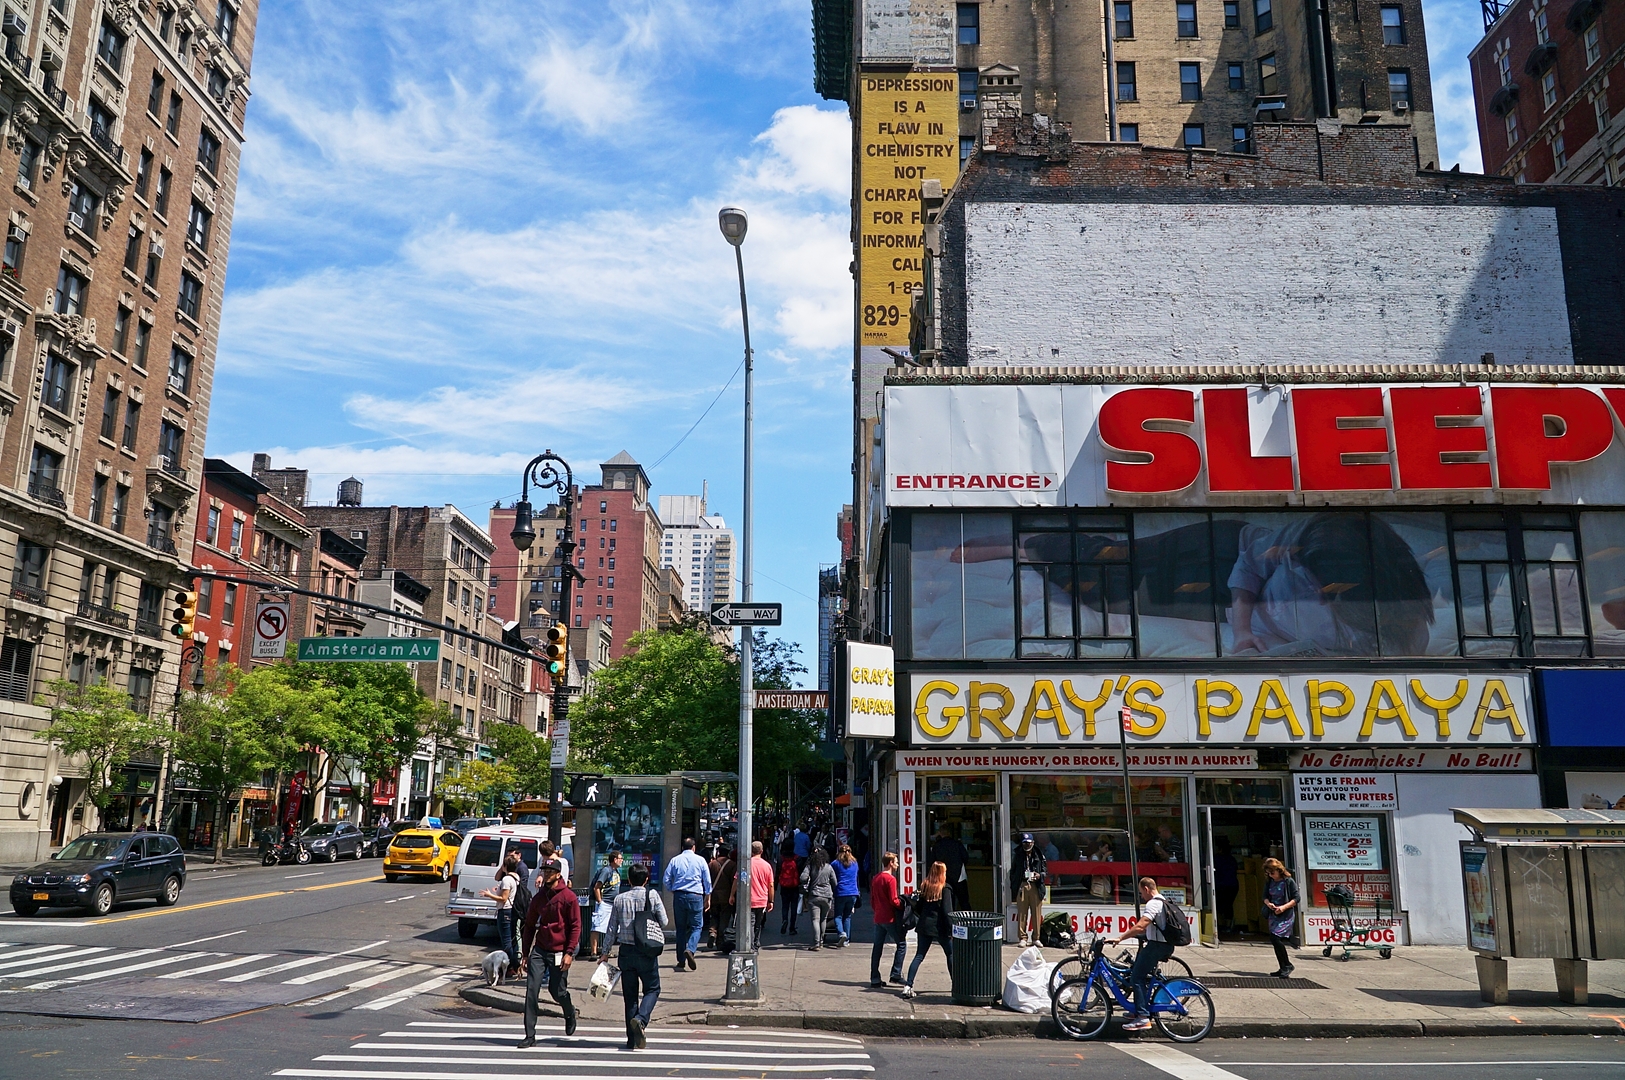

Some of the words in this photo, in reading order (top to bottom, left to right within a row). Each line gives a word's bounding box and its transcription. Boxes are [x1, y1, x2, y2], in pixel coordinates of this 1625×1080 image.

[866, 79, 954, 92] DEPRESSION
[894, 101, 908, 113] IS
[915, 102, 926, 114] A
[878, 122, 920, 135] FLAW
[928, 122, 944, 135] IN
[866, 144, 954, 157] CHEMISTRY
[894, 166, 926, 179] NOT
[873, 212, 904, 224] FOR
[862, 234, 924, 248] INFORMA
[1098, 386, 1625, 494] SLEEP
[896, 476, 1042, 490] ENTRANCE
[718, 610, 741, 619] ONE
[754, 610, 776, 619] WAY
[304, 643, 404, 656] Amsterdam
[408, 643, 432, 656] Av
[852, 666, 895, 687] GRAY'S
[758, 694, 811, 708] AMSTERDAM
[814, 694, 826, 708] AV
[851, 696, 896, 716] PAPAYA
[914, 674, 1167, 738] GRAY'S
[1194, 678, 1526, 738] PAPAYA
[904, 757, 942, 766] WHEN
[945, 756, 990, 766] YOU'RE
[992, 756, 1050, 768] HUNGRY,
[1052, 756, 1070, 766] OR
[1073, 756, 1120, 767] BROKE,
[1143, 756, 1172, 766] JUST
[1174, 756, 1188, 766] IN
[1190, 756, 1200, 766] A
[1203, 756, 1251, 766] HURRY!
[1300, 753, 1322, 768] No
[1329, 752, 1426, 768] Gimmicks!
[1446, 752, 1470, 768] No
[1475, 752, 1522, 768] Bull!
[1298, 776, 1322, 785] LET'S
[1325, 776, 1338, 785] BE
[1340, 776, 1376, 785] FRANK
[1300, 793, 1321, 801] BUY
[1324, 793, 1346, 801] OUR
[1349, 793, 1394, 801] FURTERS
[1309, 821, 1372, 829] BREAKFAST
[1348, 874, 1362, 882] BUT
[1362, 884, 1390, 892] BETTER
[1354, 918, 1403, 927] GOURMET
